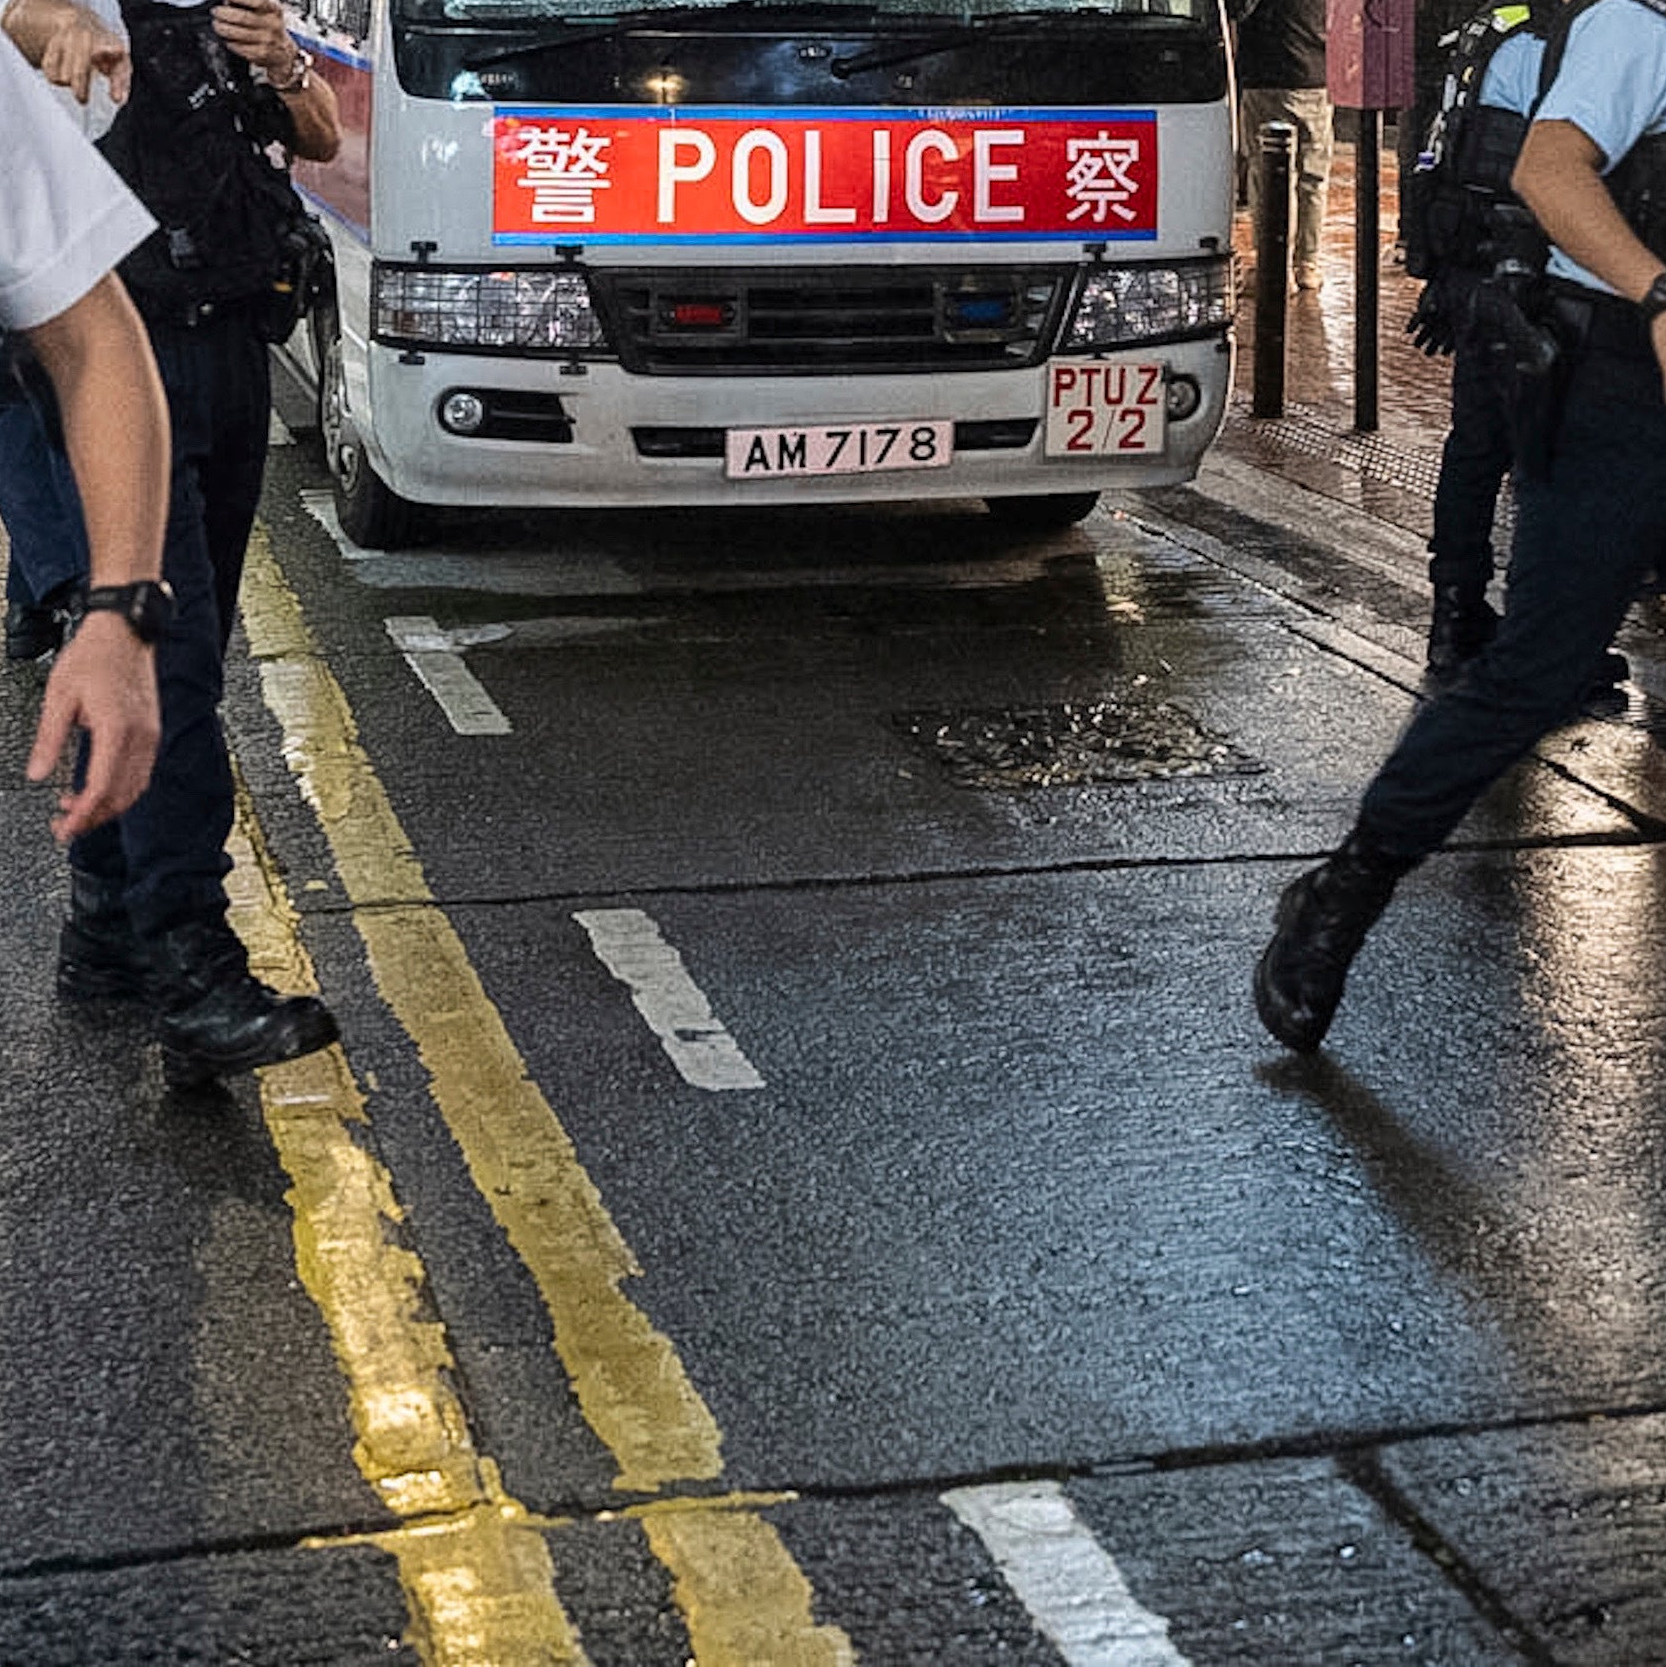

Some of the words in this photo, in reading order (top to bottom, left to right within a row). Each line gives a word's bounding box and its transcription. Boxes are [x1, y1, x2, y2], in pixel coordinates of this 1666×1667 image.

[517, 126, 612, 223] 警
[656, 128, 1025, 224] POLICE
[1065, 130, 1140, 223] 察
[1053, 367, 1127, 407] PTU
[1136, 367, 1160, 407] Z
[745, 432, 808, 472] AM
[825, 426, 938, 468] 7178
[1067, 408, 1148, 452] 2/2
